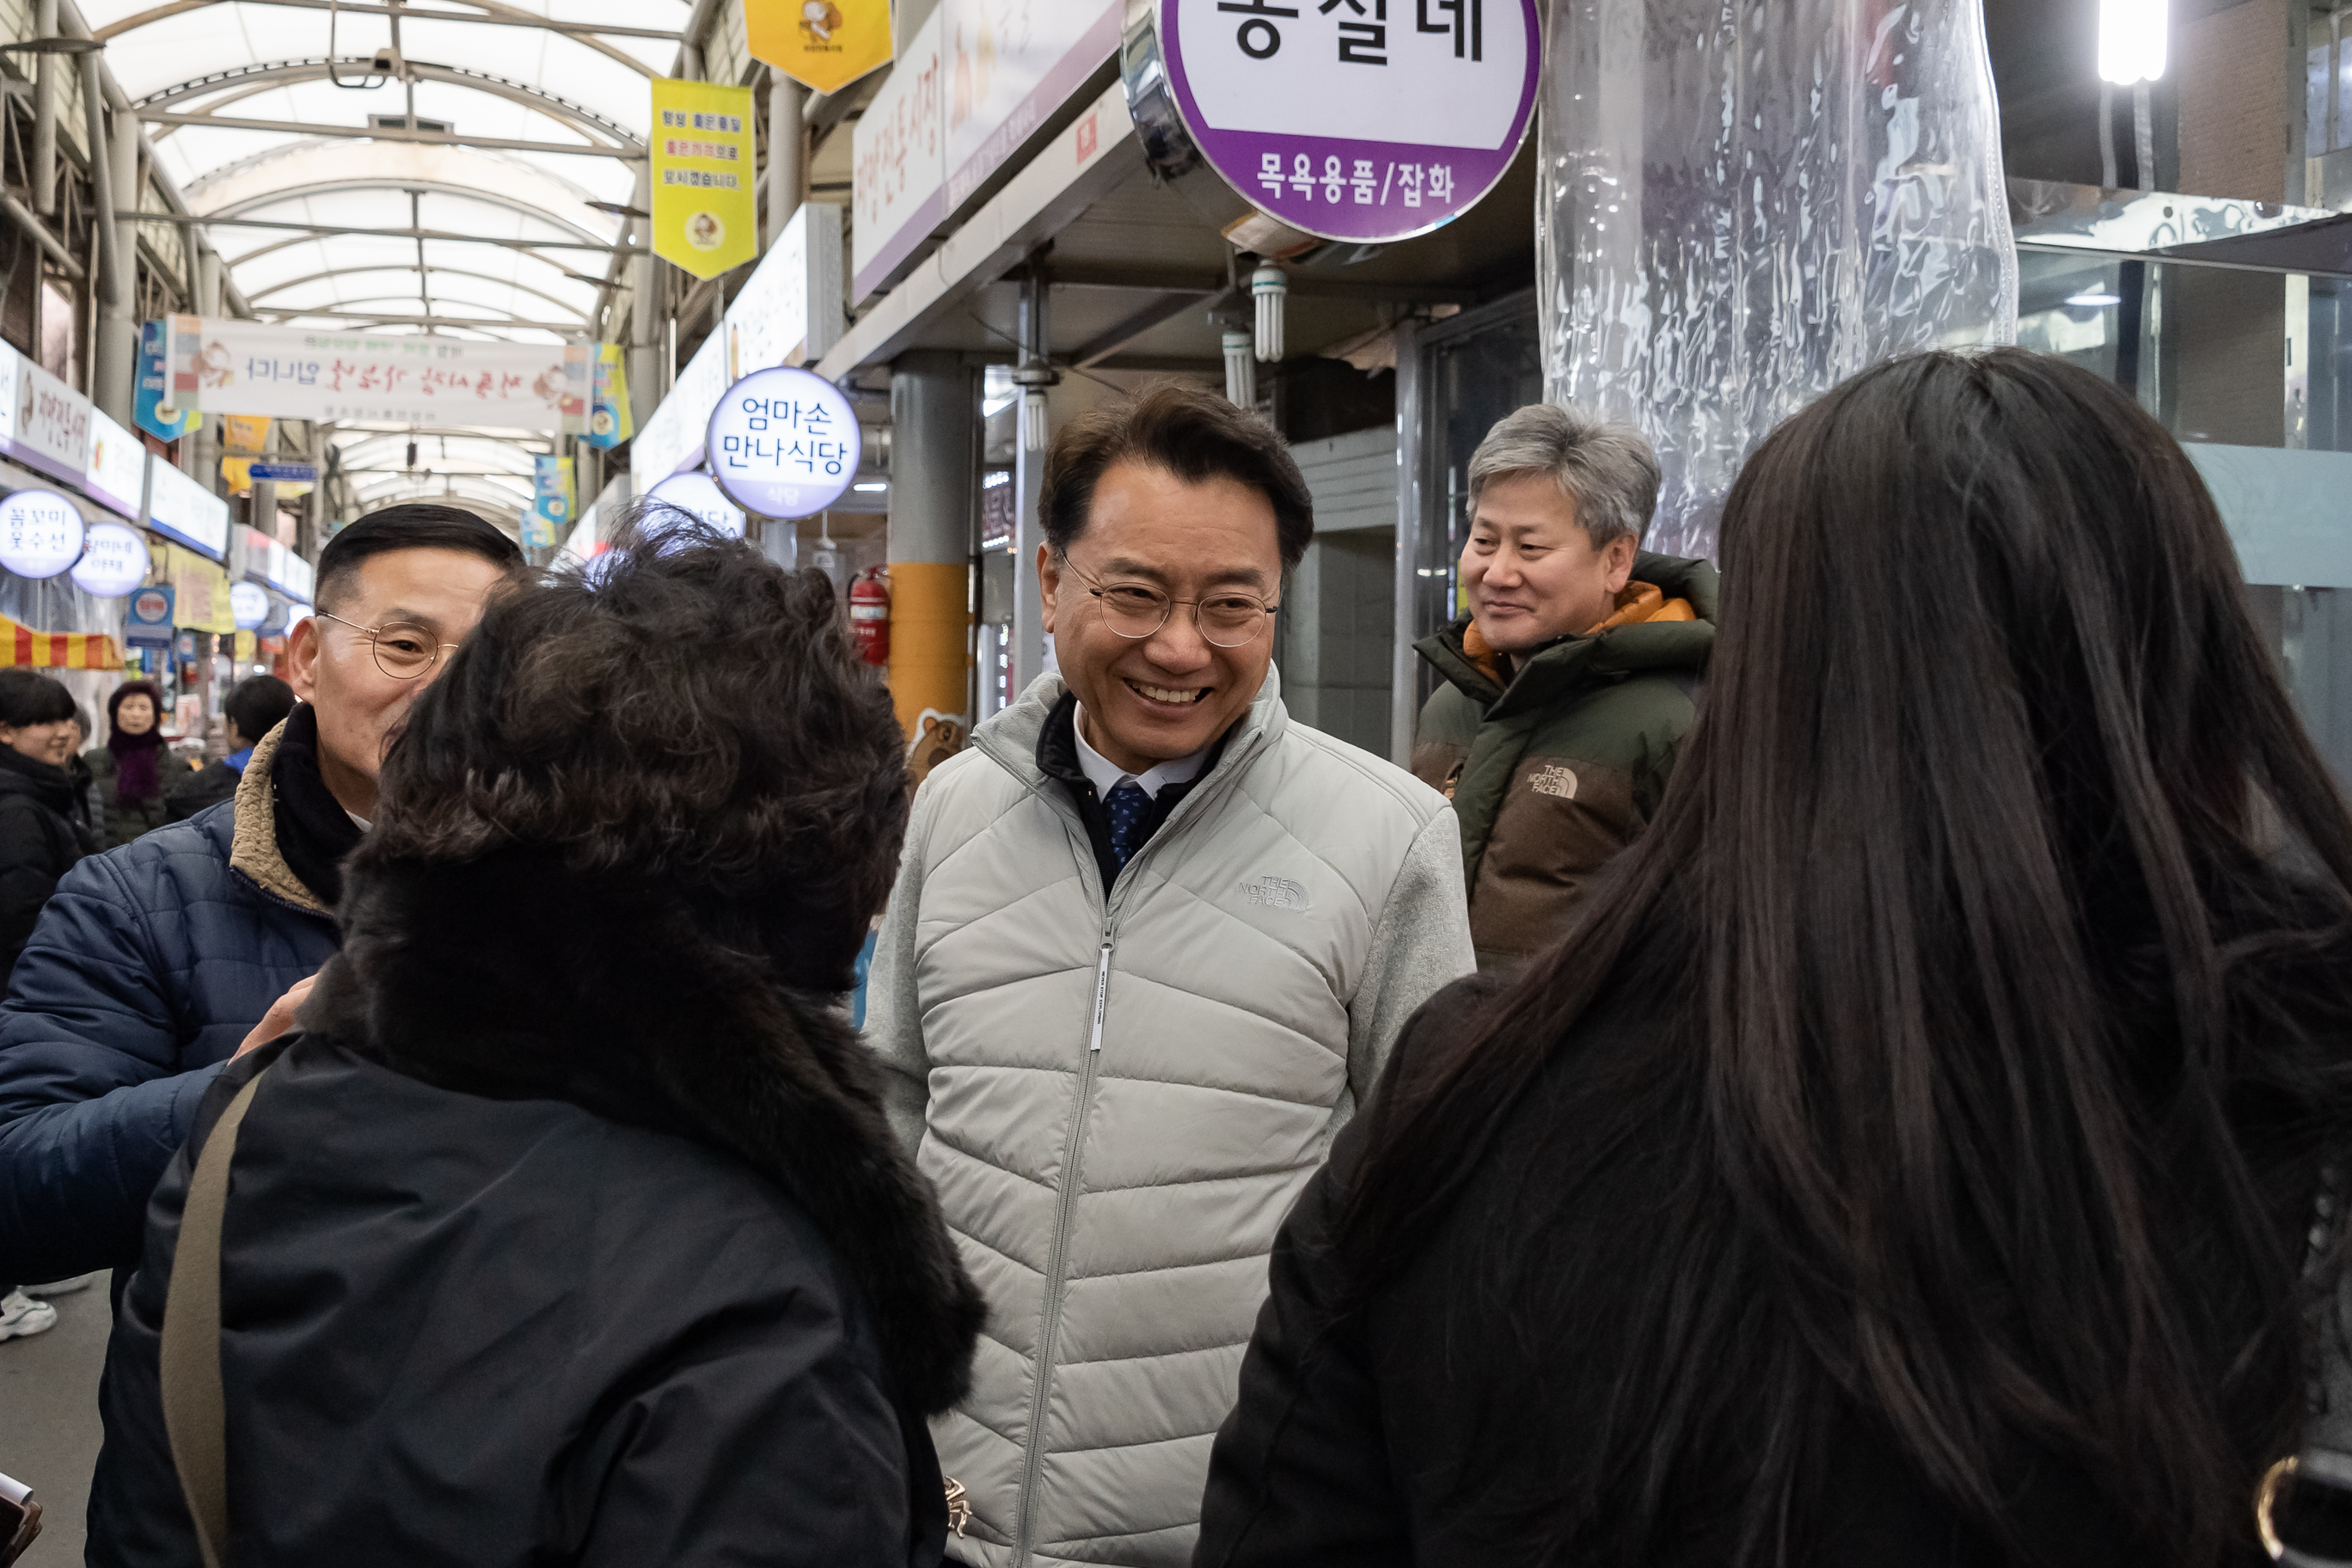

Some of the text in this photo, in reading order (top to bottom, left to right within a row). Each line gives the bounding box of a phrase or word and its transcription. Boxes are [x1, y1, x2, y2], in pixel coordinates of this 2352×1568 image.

[1257, 153, 1455, 207] 목욕용품/잡화
[743, 398, 832, 436] 엄마손
[723, 435, 848, 475] 만나식당
[1545, 764, 1564, 776] THE
[1527, 773, 1560, 786] NORTH
[1531, 782, 1557, 795] FACE
[1262, 874, 1289, 889] THE
[1239, 882, 1287, 898] NORTH
[1247, 894, 1283, 907] FACE
